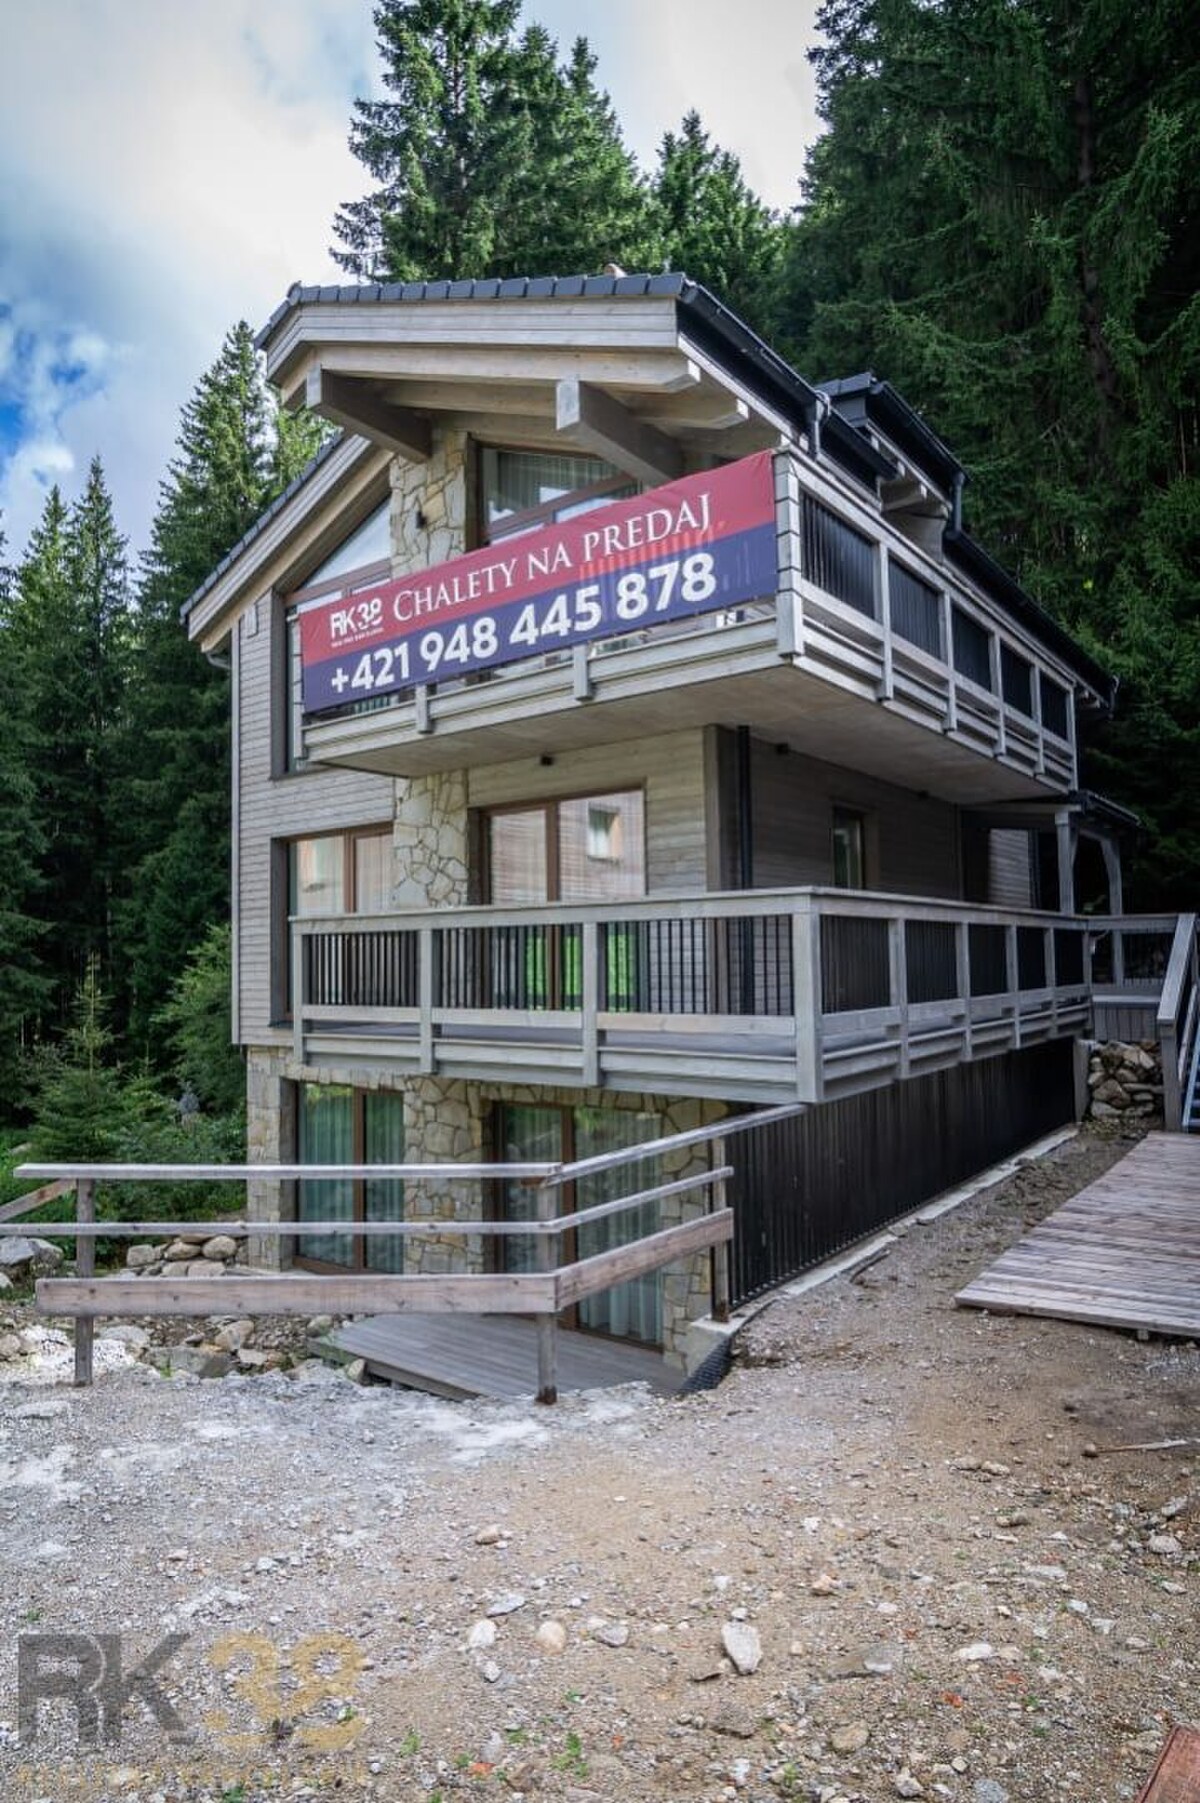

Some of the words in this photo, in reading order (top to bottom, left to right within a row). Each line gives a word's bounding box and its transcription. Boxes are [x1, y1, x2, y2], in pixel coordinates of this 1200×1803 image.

[331, 642, 410, 693] +421
[419, 617, 499, 672] 948
[509, 585, 602, 646] 445
[617, 553, 717, 619] 878
[393, 558, 517, 621] CHALETY
[527, 543, 573, 579] NA
[584, 493, 711, 562] PREDAJ
